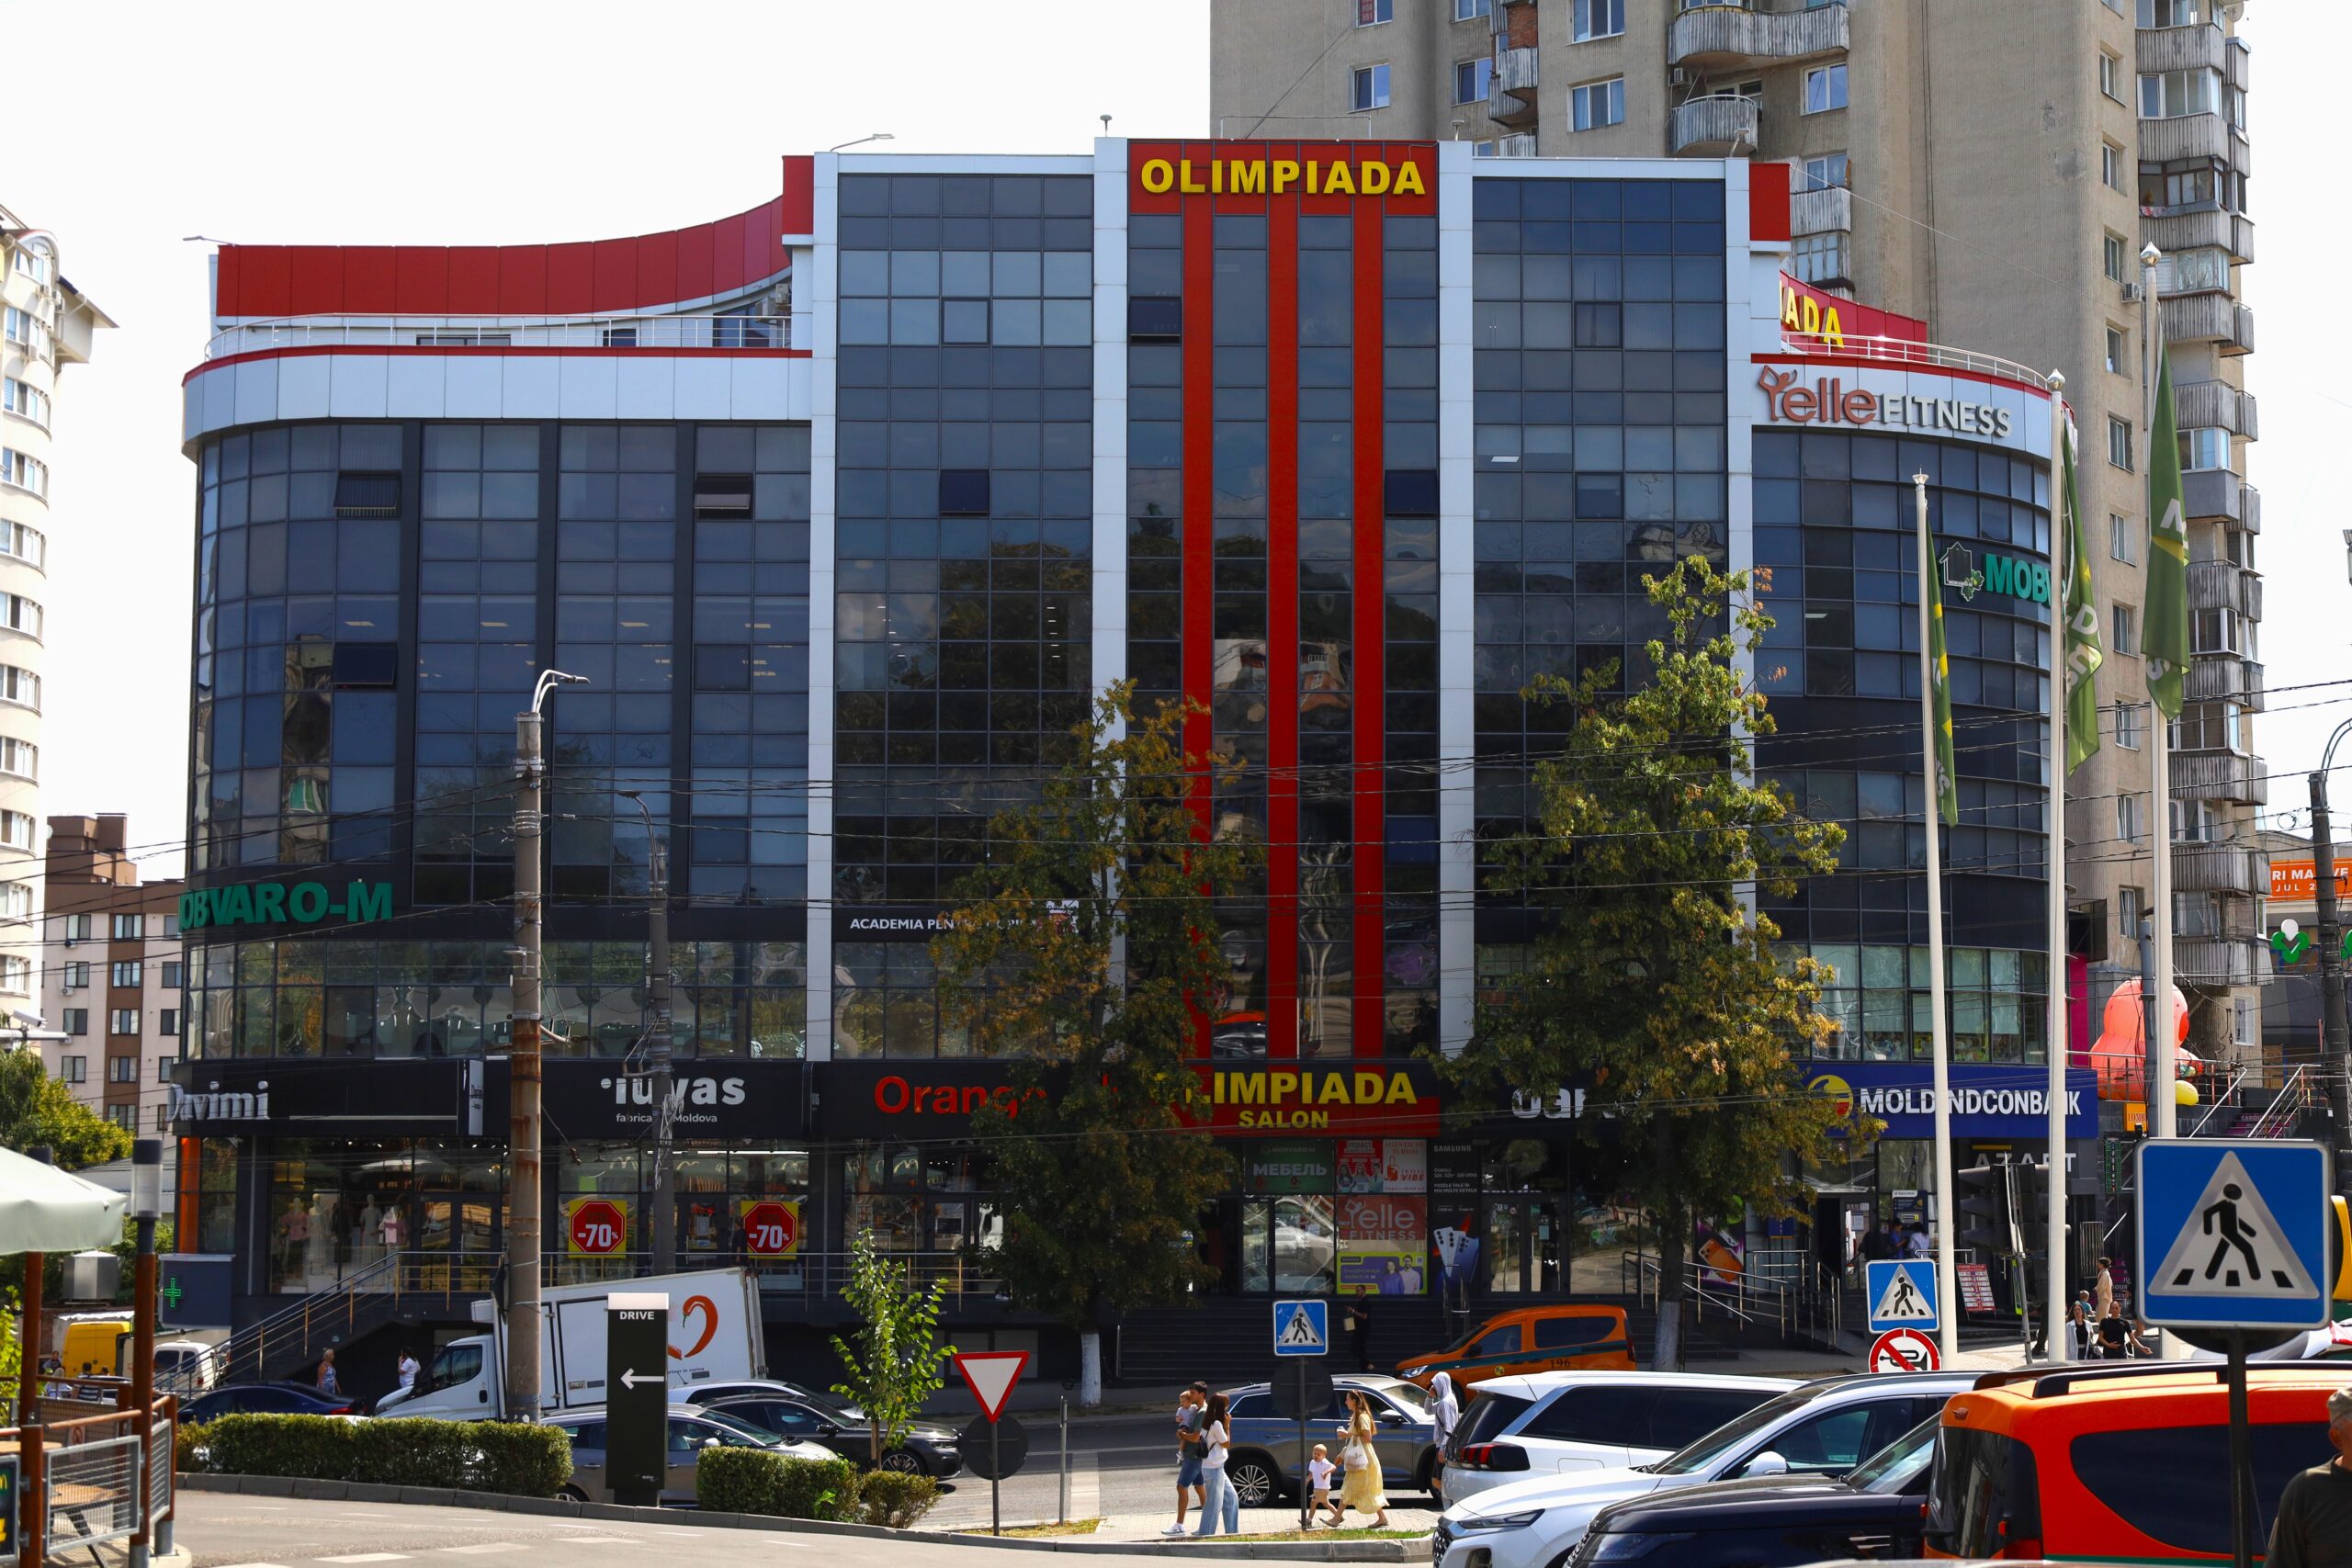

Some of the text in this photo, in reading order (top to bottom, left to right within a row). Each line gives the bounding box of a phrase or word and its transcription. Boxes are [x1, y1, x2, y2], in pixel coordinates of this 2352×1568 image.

[1141, 158, 1426, 196] OLIMPIADA
[1883, 394, 2012, 438] FITNESS
[850, 919, 923, 930] ACADEMIA
[1860, 1088, 2081, 1116] MOLDNDCONBK
[1238, 1110, 1329, 1129] SALON
[1253, 1163, 1328, 1177] МЕБЕЛЬ
[577, 1223, 618, 1247] -70%
[749, 1224, 789, 1248] -70%
[1350, 1230, 1416, 1241] FITNESS
[619, 1311, 655, 1320] DRIVE
[1550, 1358, 1571, 1370] 196
